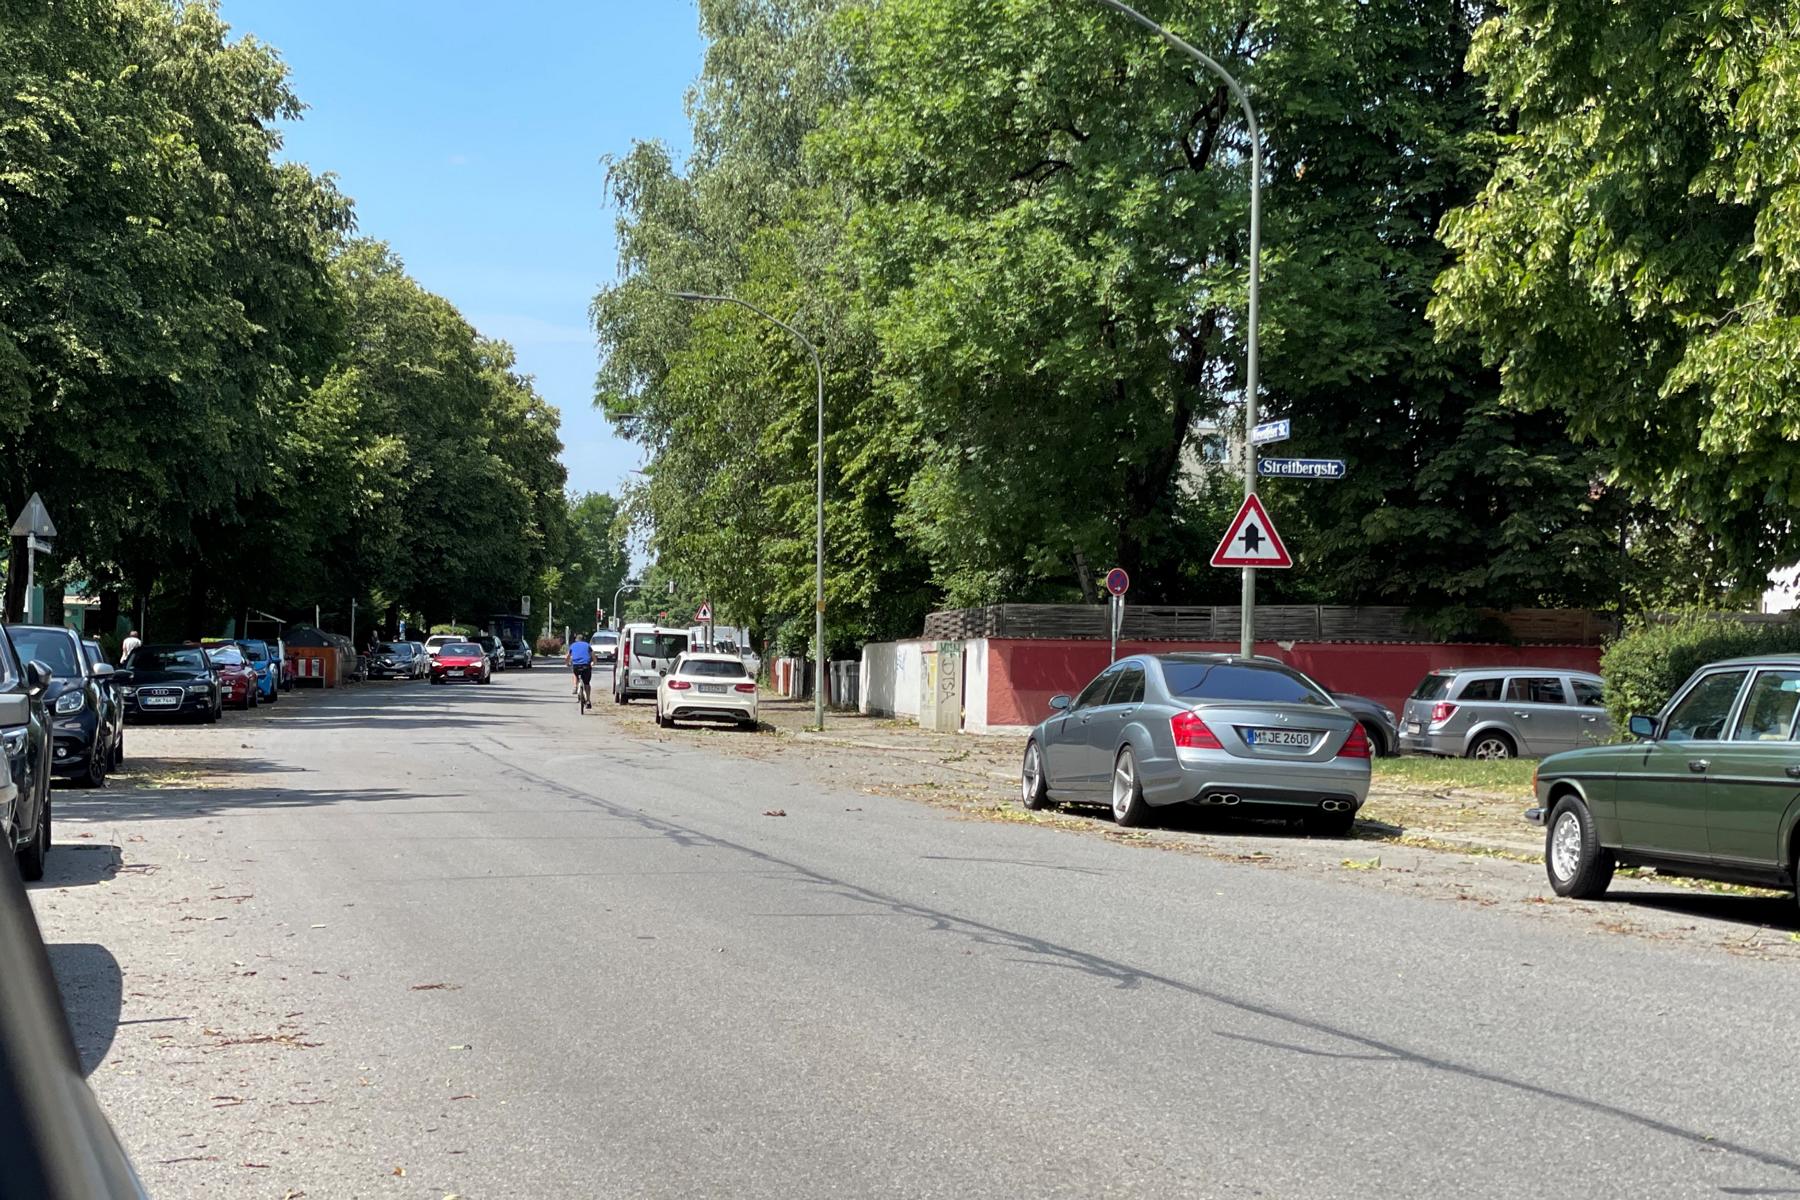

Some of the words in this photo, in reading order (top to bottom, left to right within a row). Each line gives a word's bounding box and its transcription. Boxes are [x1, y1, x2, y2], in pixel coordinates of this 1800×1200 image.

[1263, 460, 1338, 477] Streitbergstr.
[1268, 732, 1282, 744] JE
[1283, 733, 1310, 745] 2608
